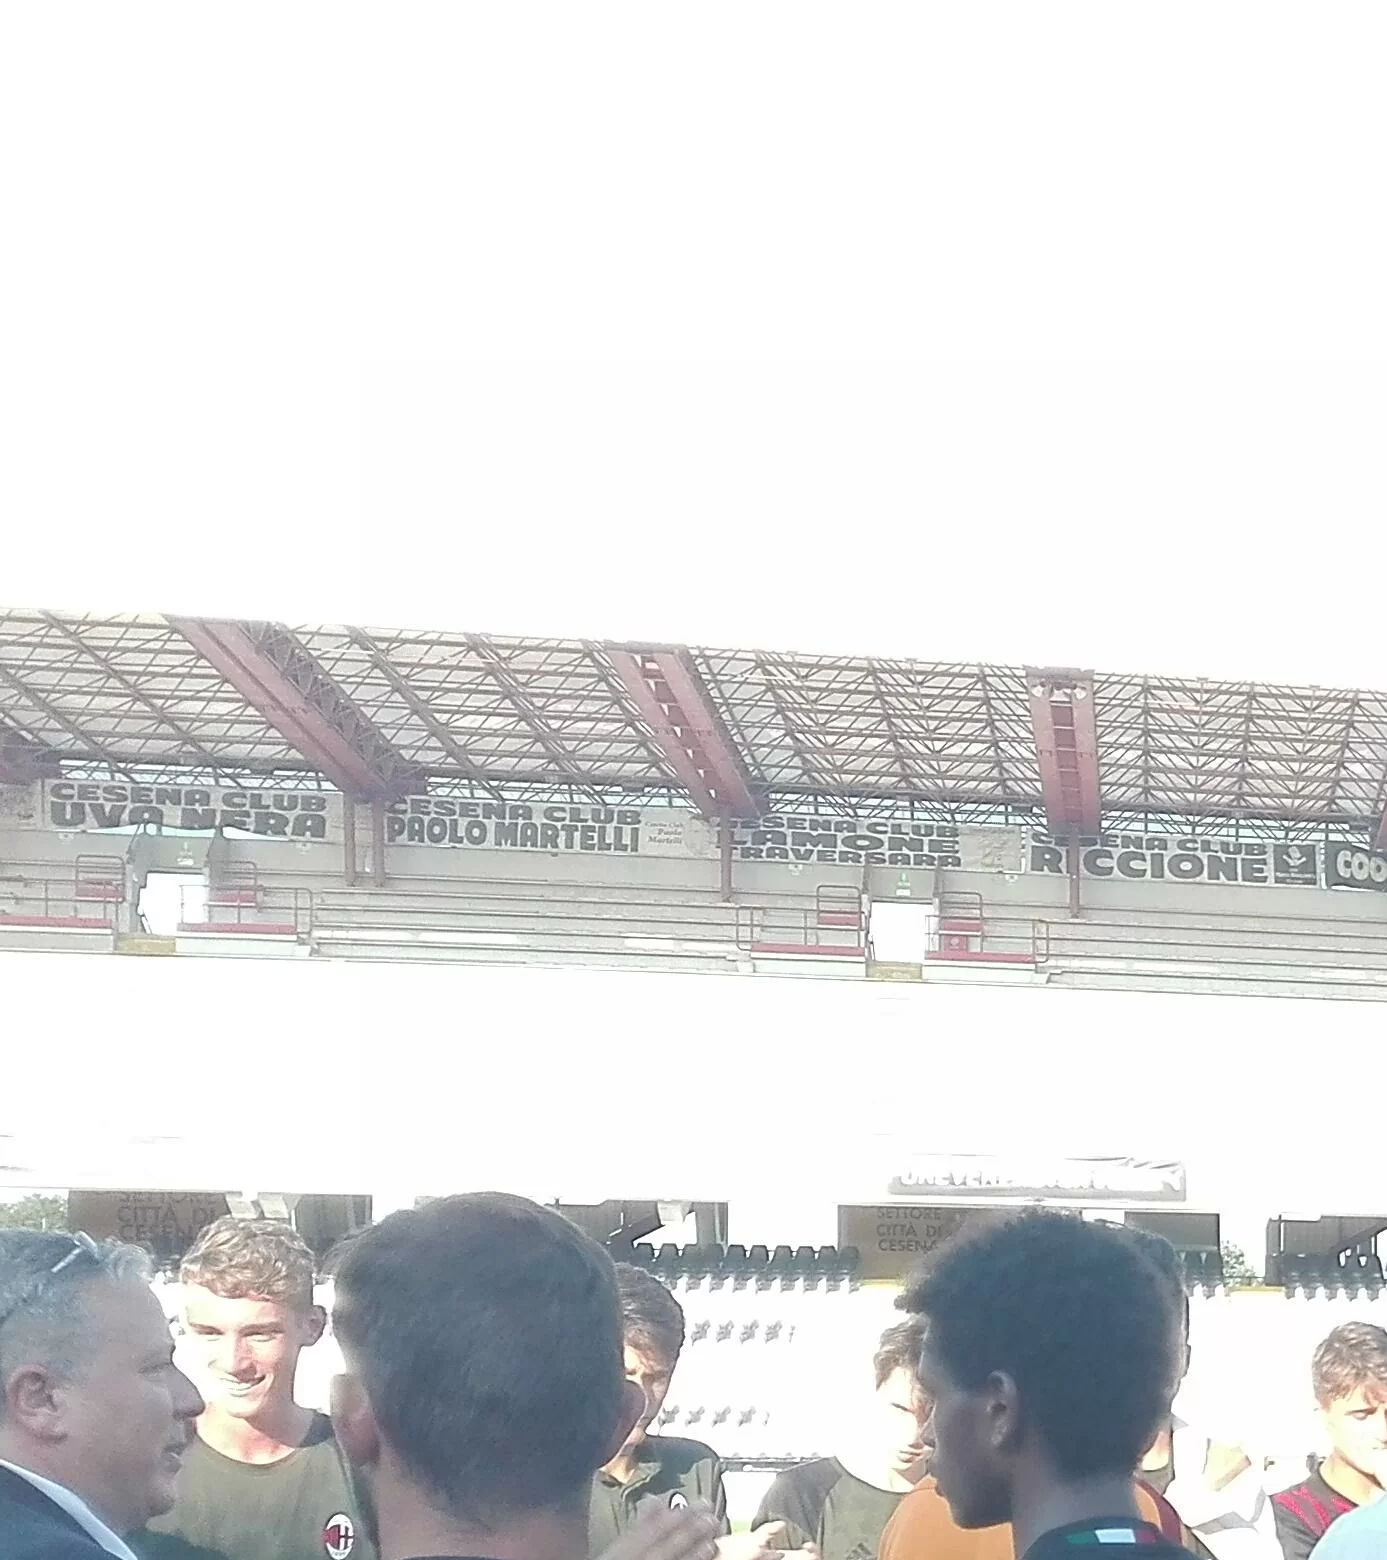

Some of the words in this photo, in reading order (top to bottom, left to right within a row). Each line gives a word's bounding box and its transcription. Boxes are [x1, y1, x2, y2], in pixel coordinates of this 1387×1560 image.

[50, 784, 210, 806] CESENA
[221, 792, 327, 811] CLUB
[50, 802, 163, 827] UVA
[181, 808, 326, 838] NERA
[386, 799, 533, 820] CESENA
[544, 806, 641, 825] CLUB
[388, 815, 487, 845] PAOLO
[494, 821, 640, 852] MARTELLI
[717, 829, 960, 854] LAMONE
[866, 822, 960, 838] CLUB
[1177, 838, 1268, 857] CLUB
